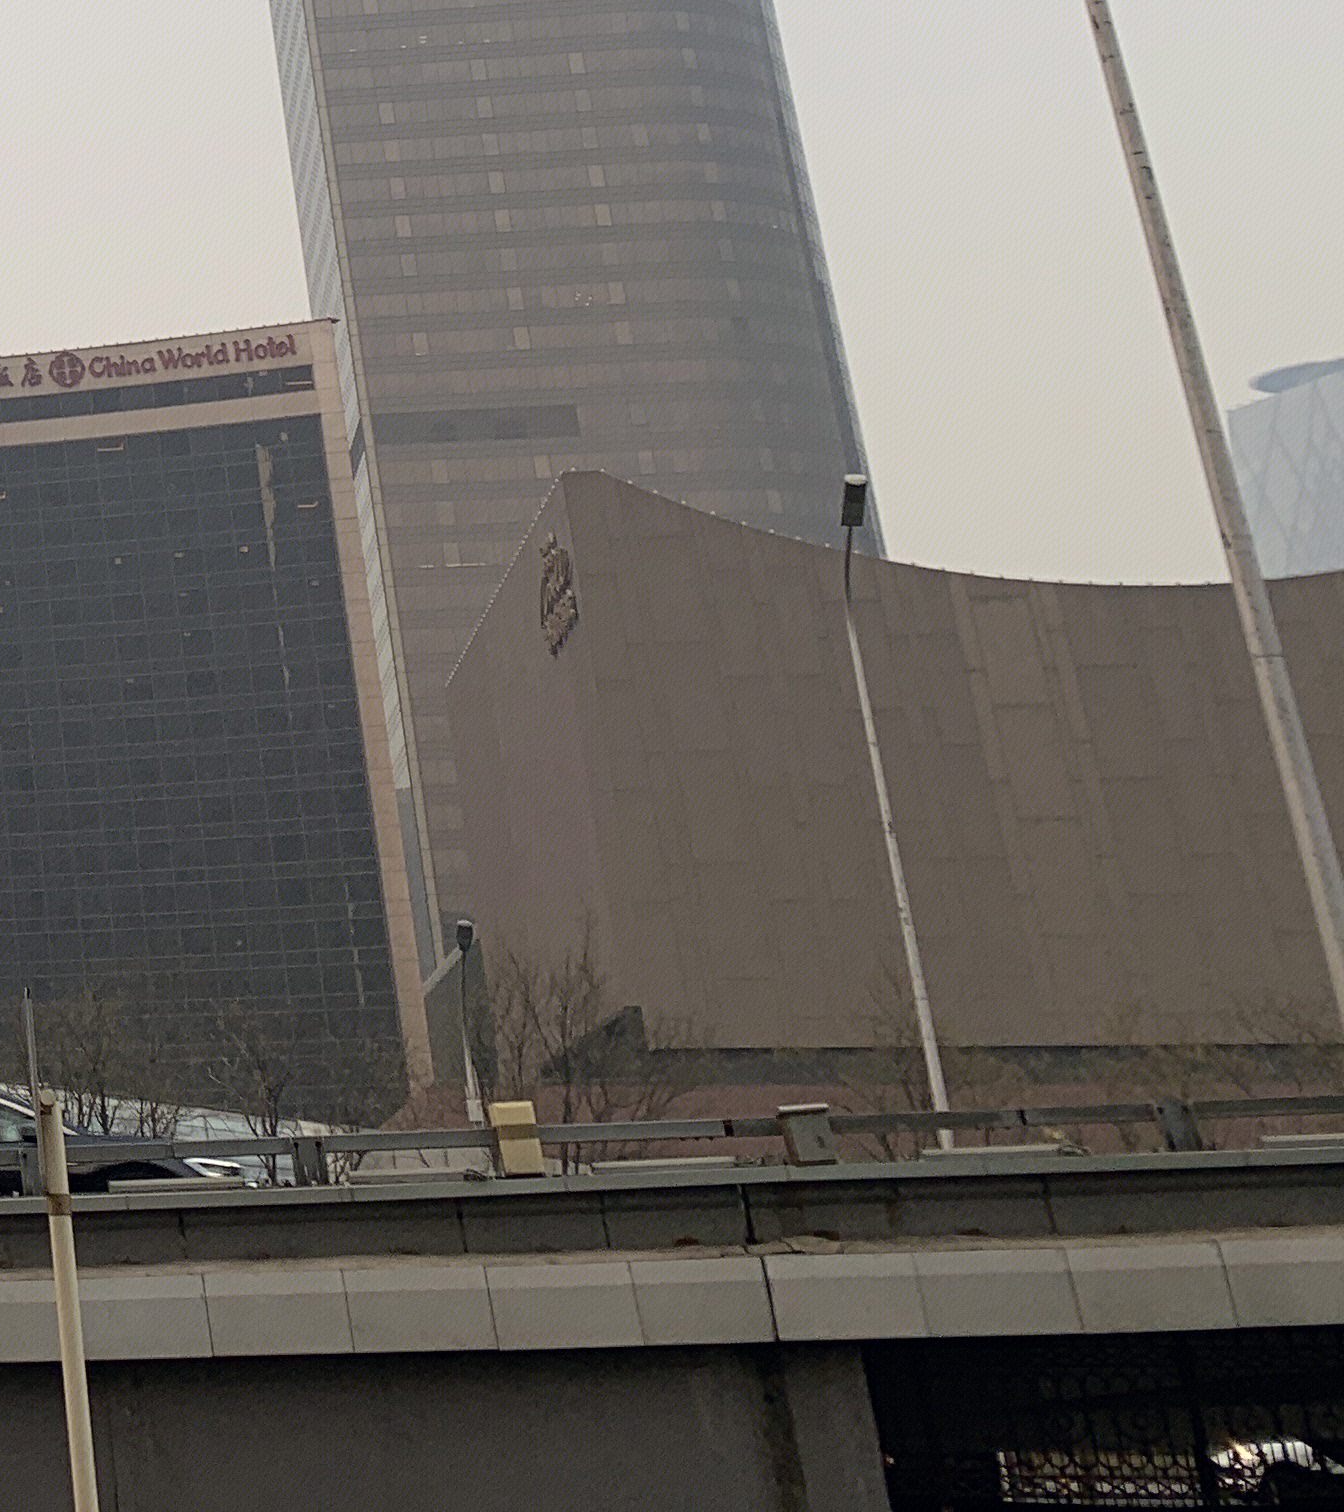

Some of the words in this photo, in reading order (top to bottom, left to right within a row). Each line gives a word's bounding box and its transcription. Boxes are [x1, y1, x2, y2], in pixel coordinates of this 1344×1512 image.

[88, 353, 158, 379] China
[157, 341, 229, 371] World
[232, 333, 297, 364] Hotel
